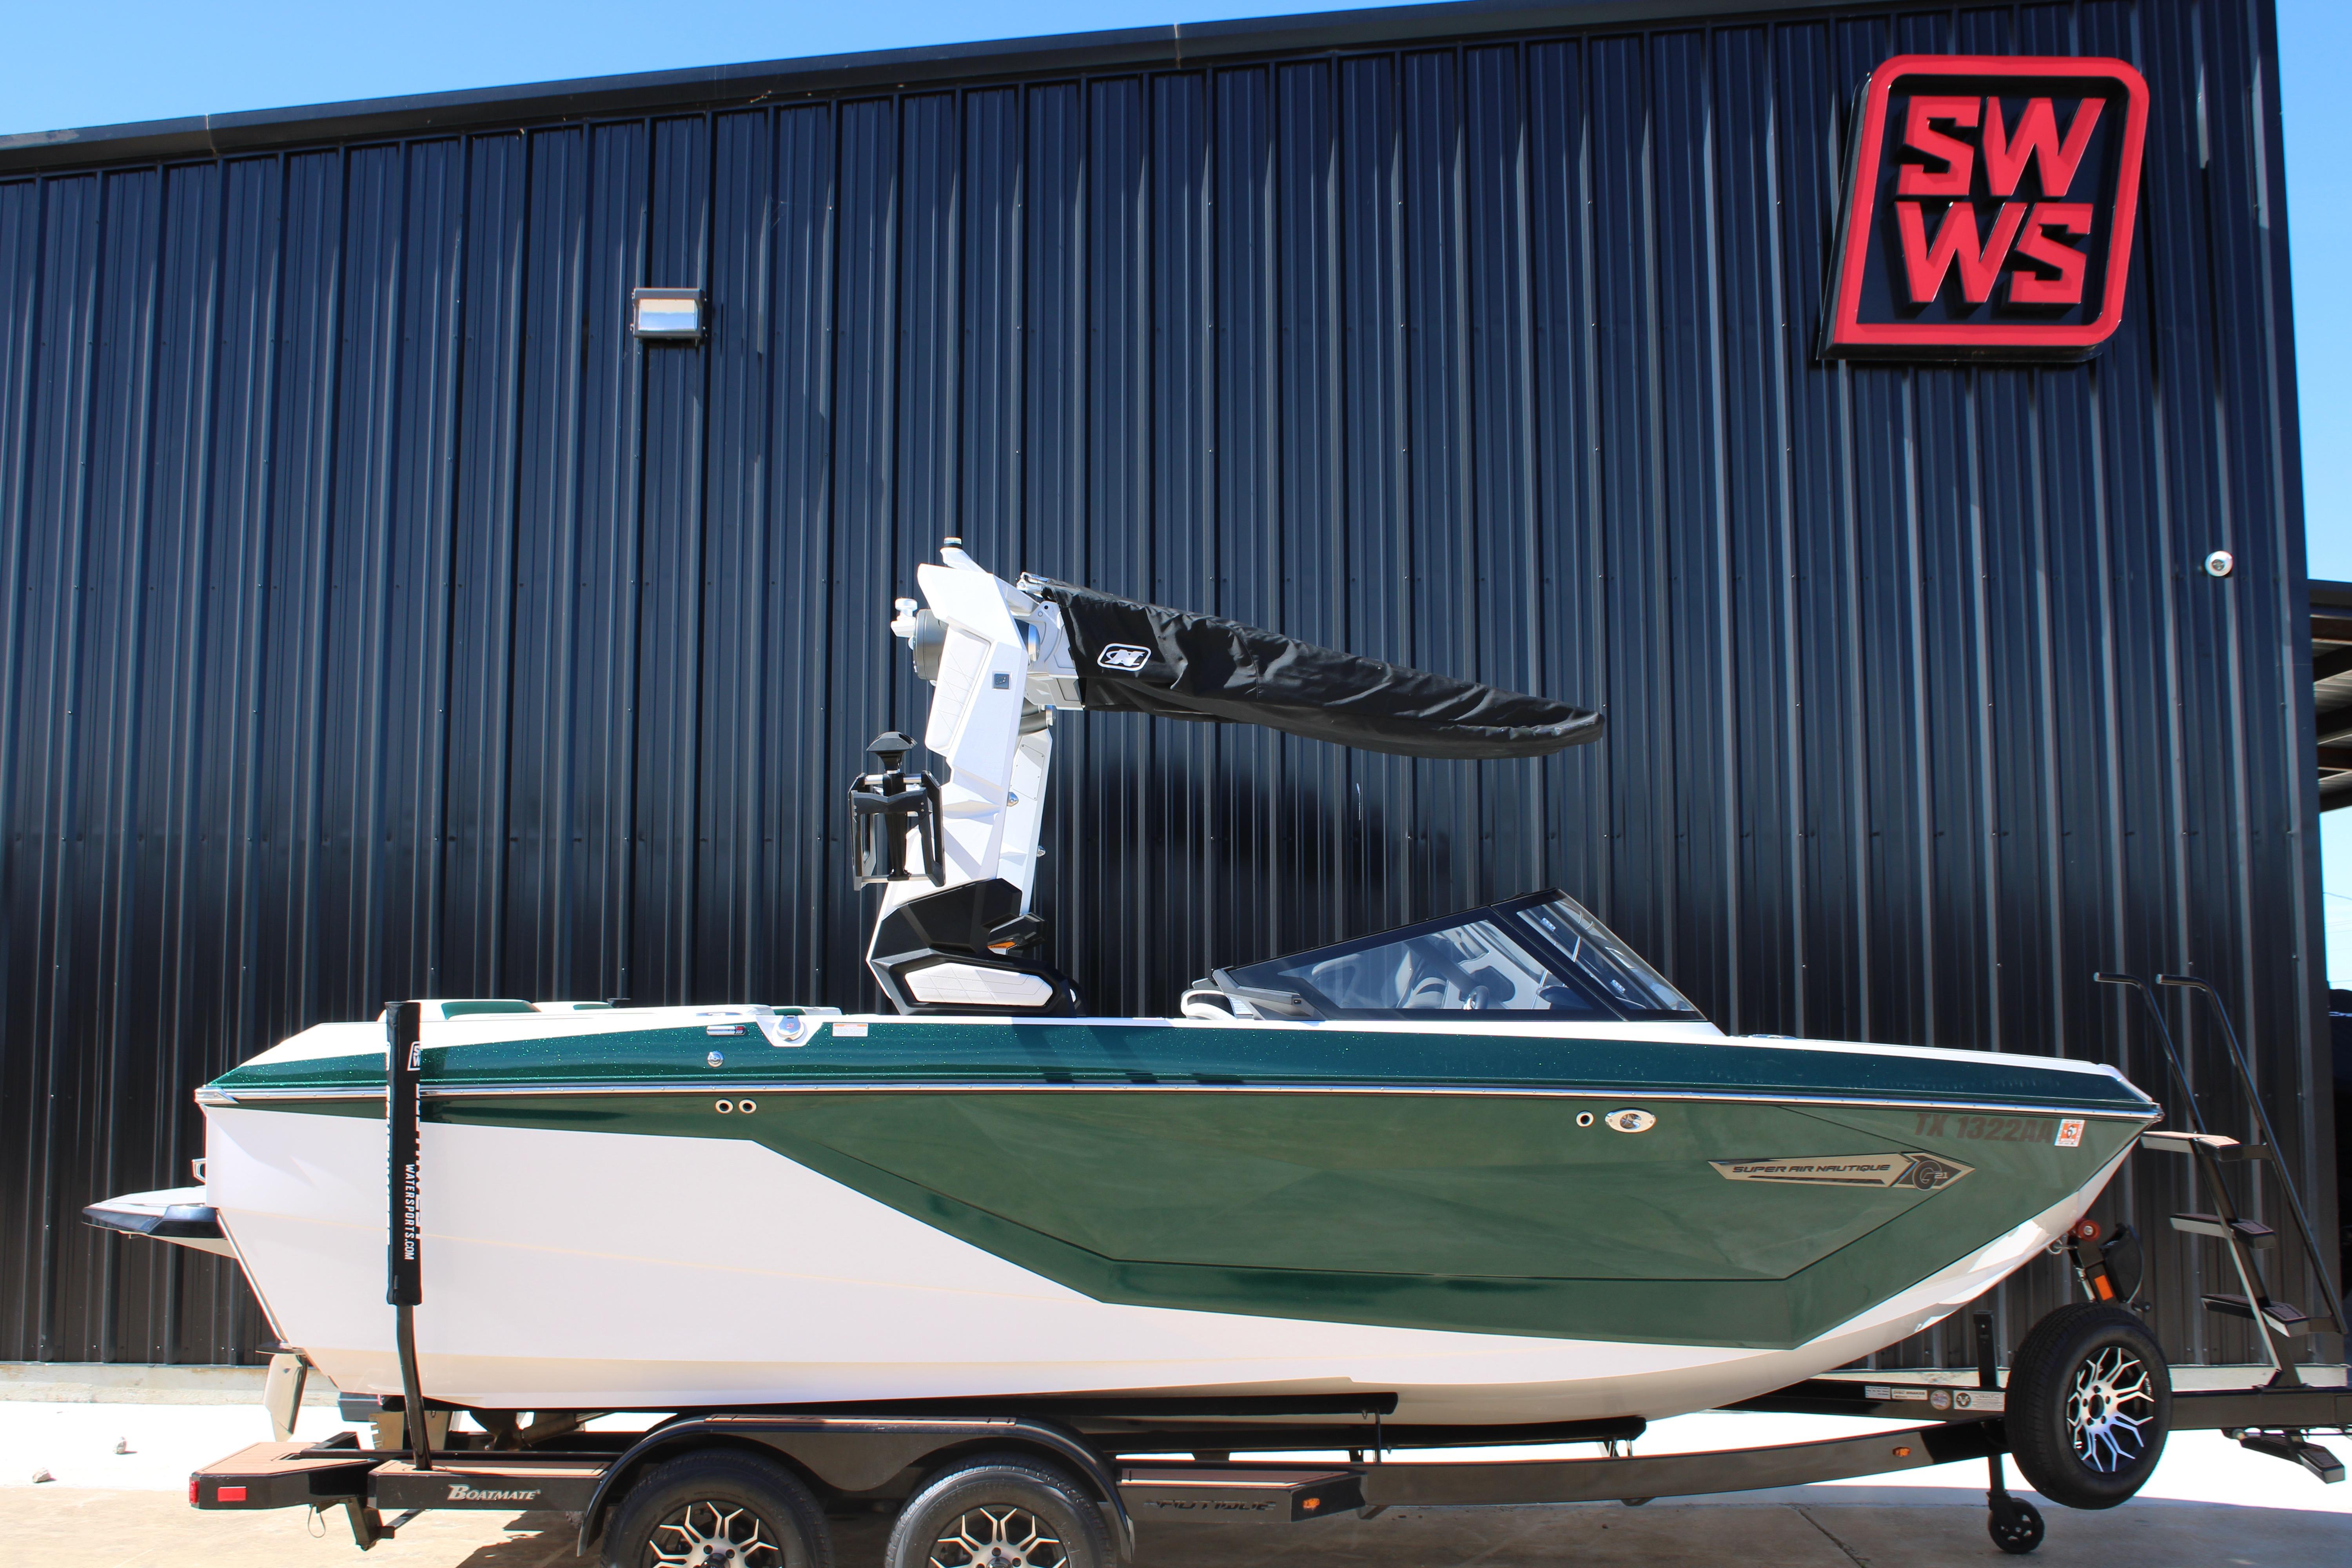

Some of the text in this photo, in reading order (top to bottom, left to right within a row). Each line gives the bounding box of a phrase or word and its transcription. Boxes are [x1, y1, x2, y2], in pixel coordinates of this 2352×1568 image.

[1896, 96, 2106, 197] SW
[1895, 201, 2093, 304] WS
[1915, 1113, 1949, 1137] TX
[405, 1164, 415, 1260] WATERSPORTS.COM
[447, 1484, 537, 1500] BOATMATE
